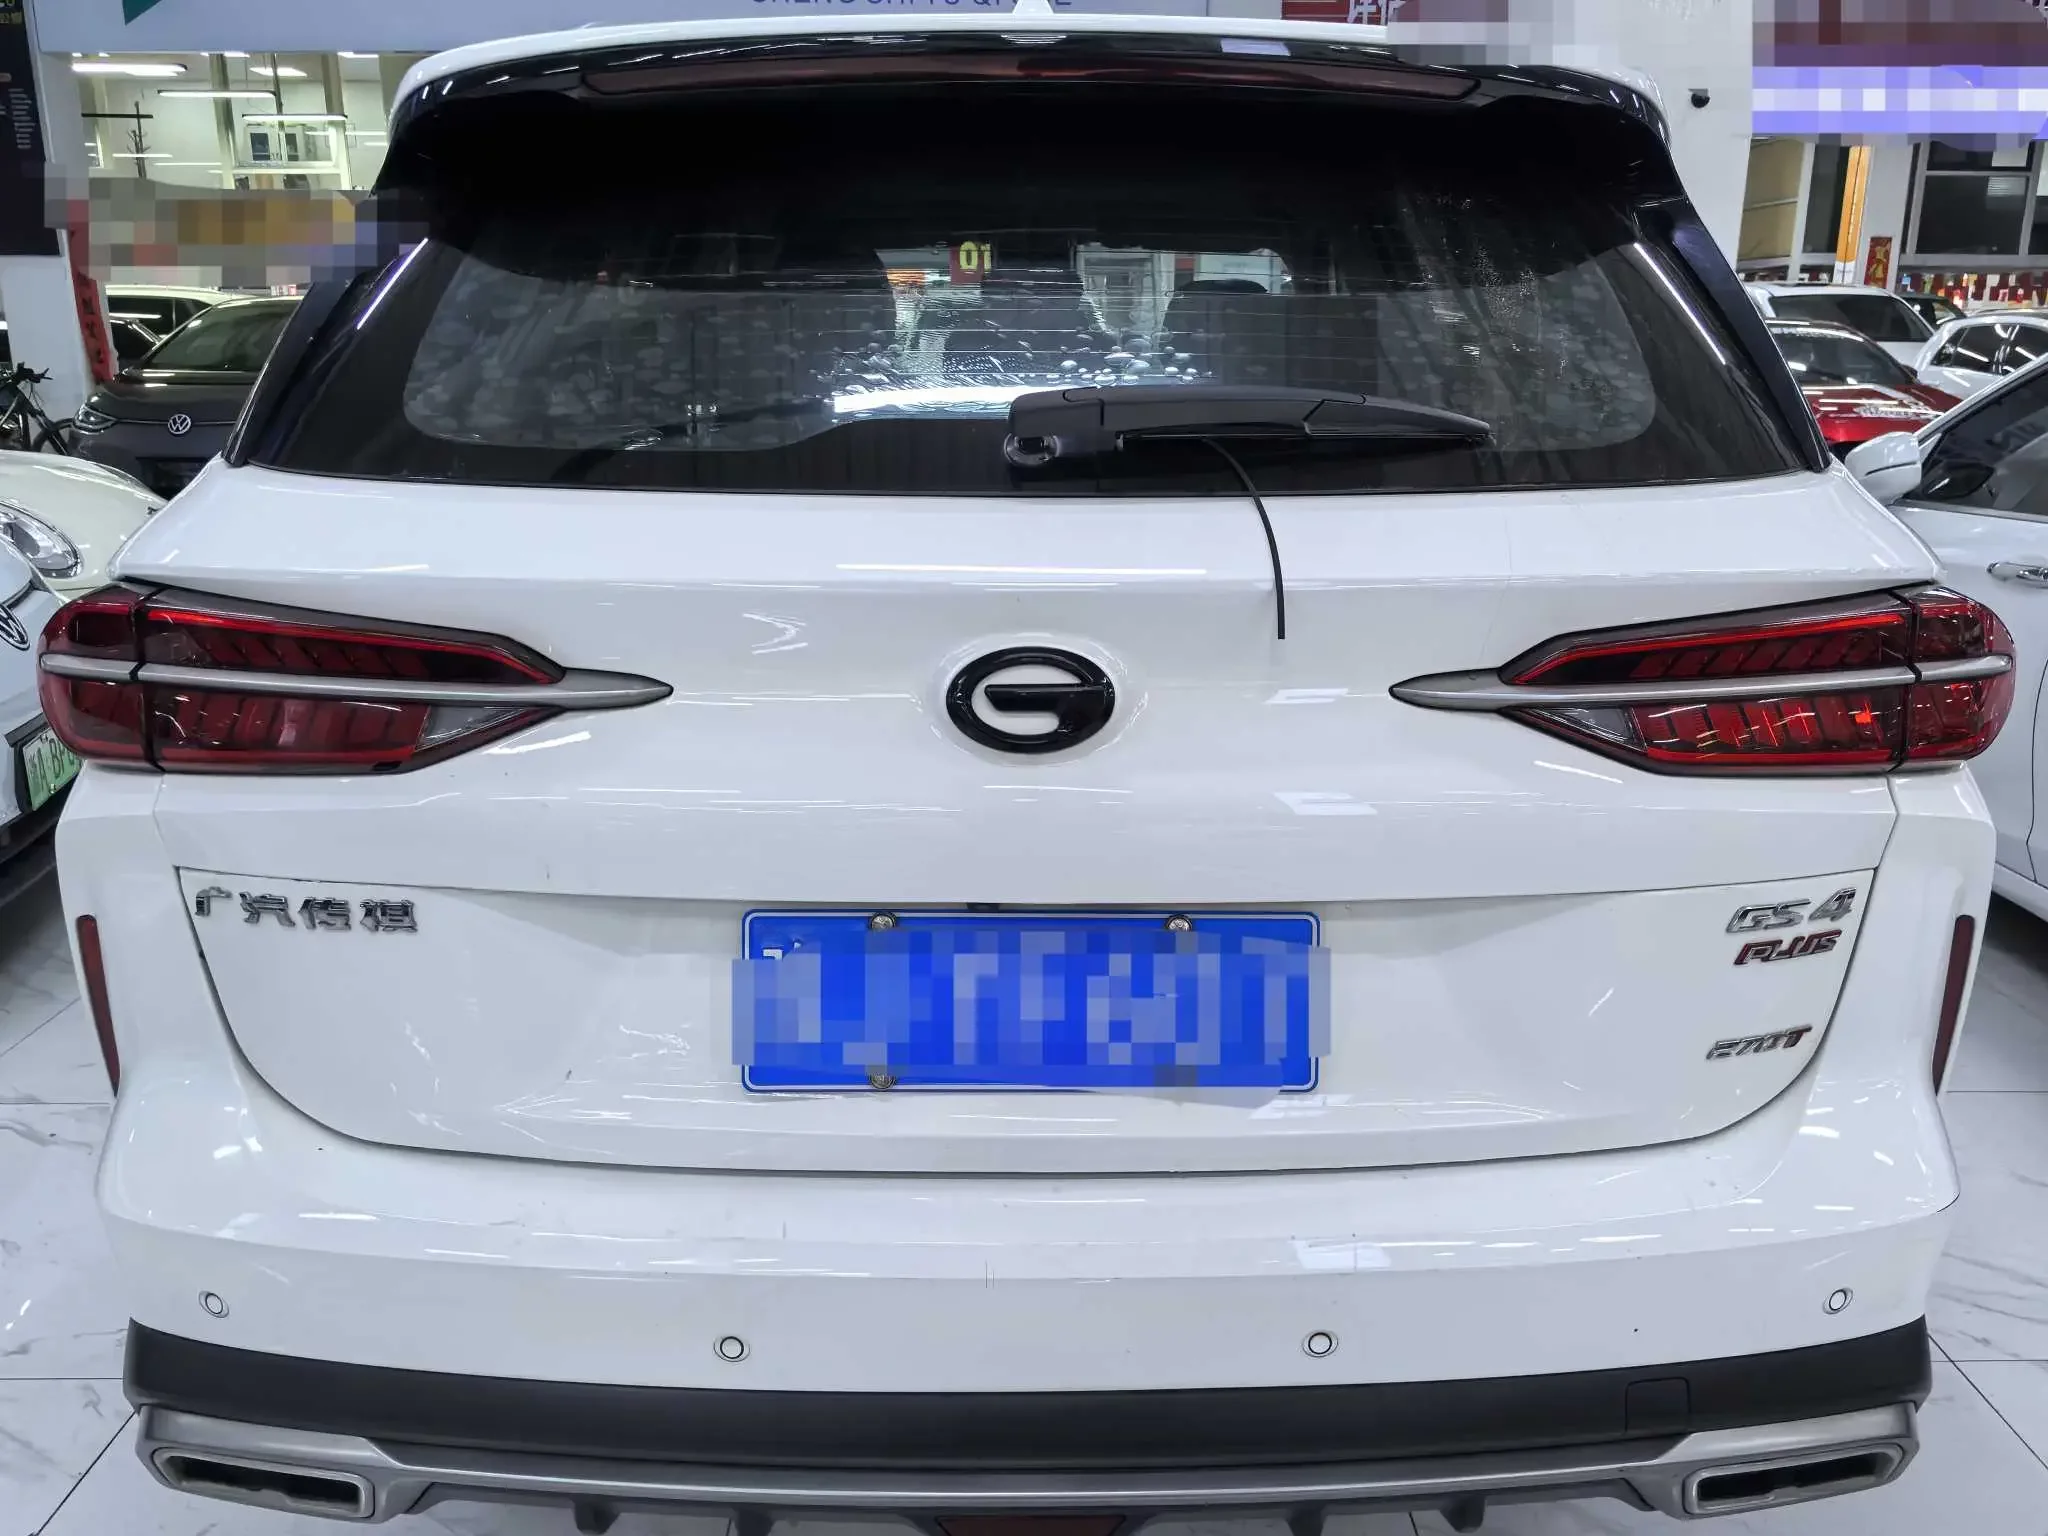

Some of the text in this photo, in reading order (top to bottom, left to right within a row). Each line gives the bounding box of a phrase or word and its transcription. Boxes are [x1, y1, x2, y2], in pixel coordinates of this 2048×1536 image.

[195, 886, 417, 932] 广汽传祺
[1726, 887, 1857, 933] GS4
[1733, 929, 1843, 965] PLUS
